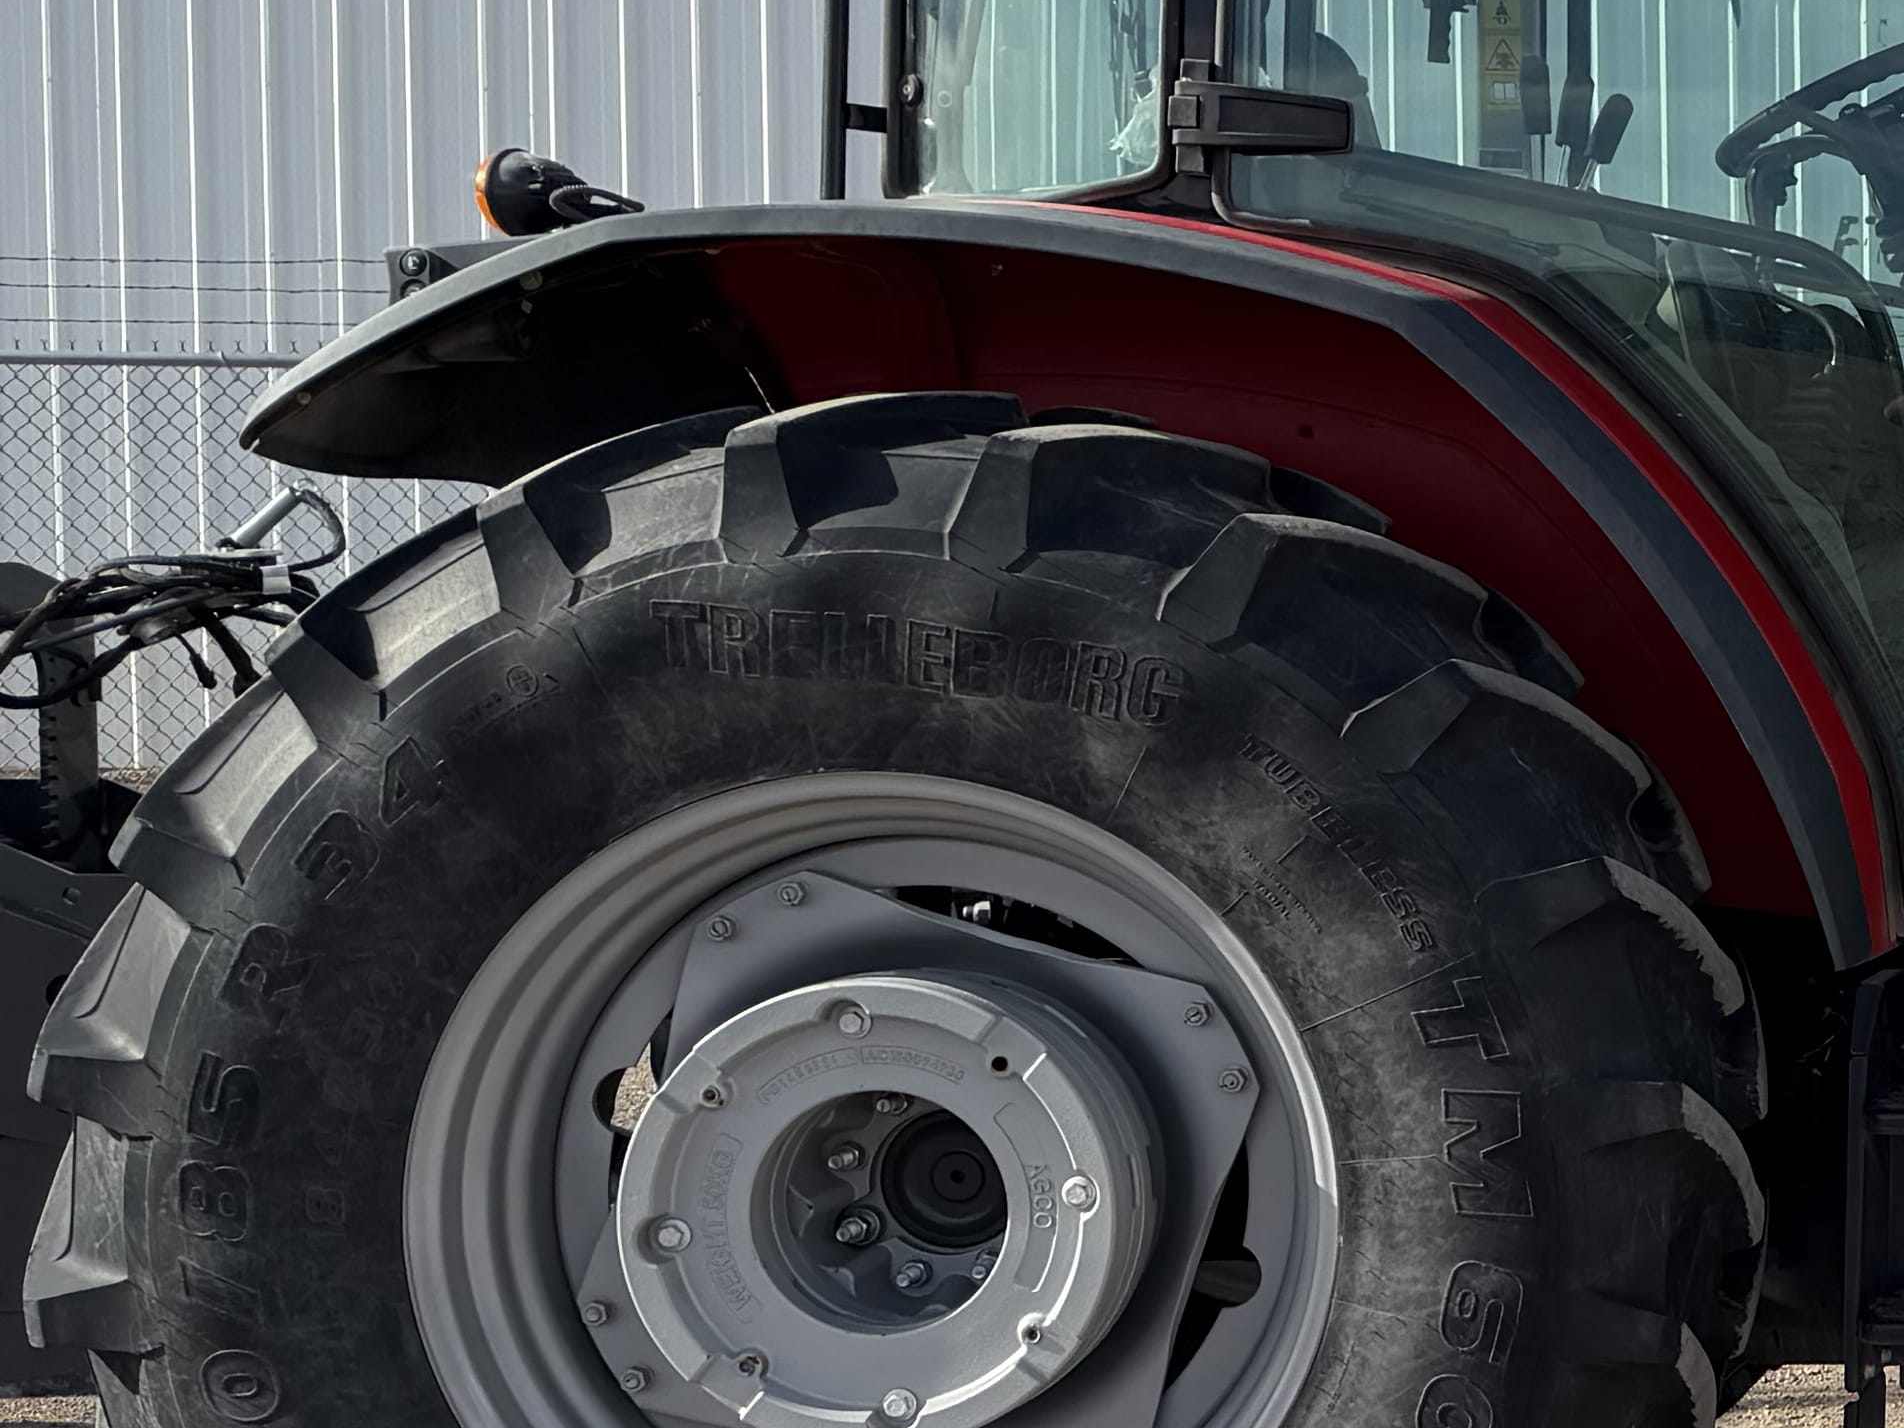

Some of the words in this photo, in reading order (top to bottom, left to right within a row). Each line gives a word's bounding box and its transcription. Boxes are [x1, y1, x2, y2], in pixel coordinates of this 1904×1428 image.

[649, 597, 1190, 728] TRELLEBORG
[218, 921, 325, 1003] R
[291, 736, 445, 902] 34
[1240, 733, 1435, 953] TUBELESS
[1023, 1164, 1055, 1229] AGCO
[703, 1218, 752, 1312] WEIGHT
